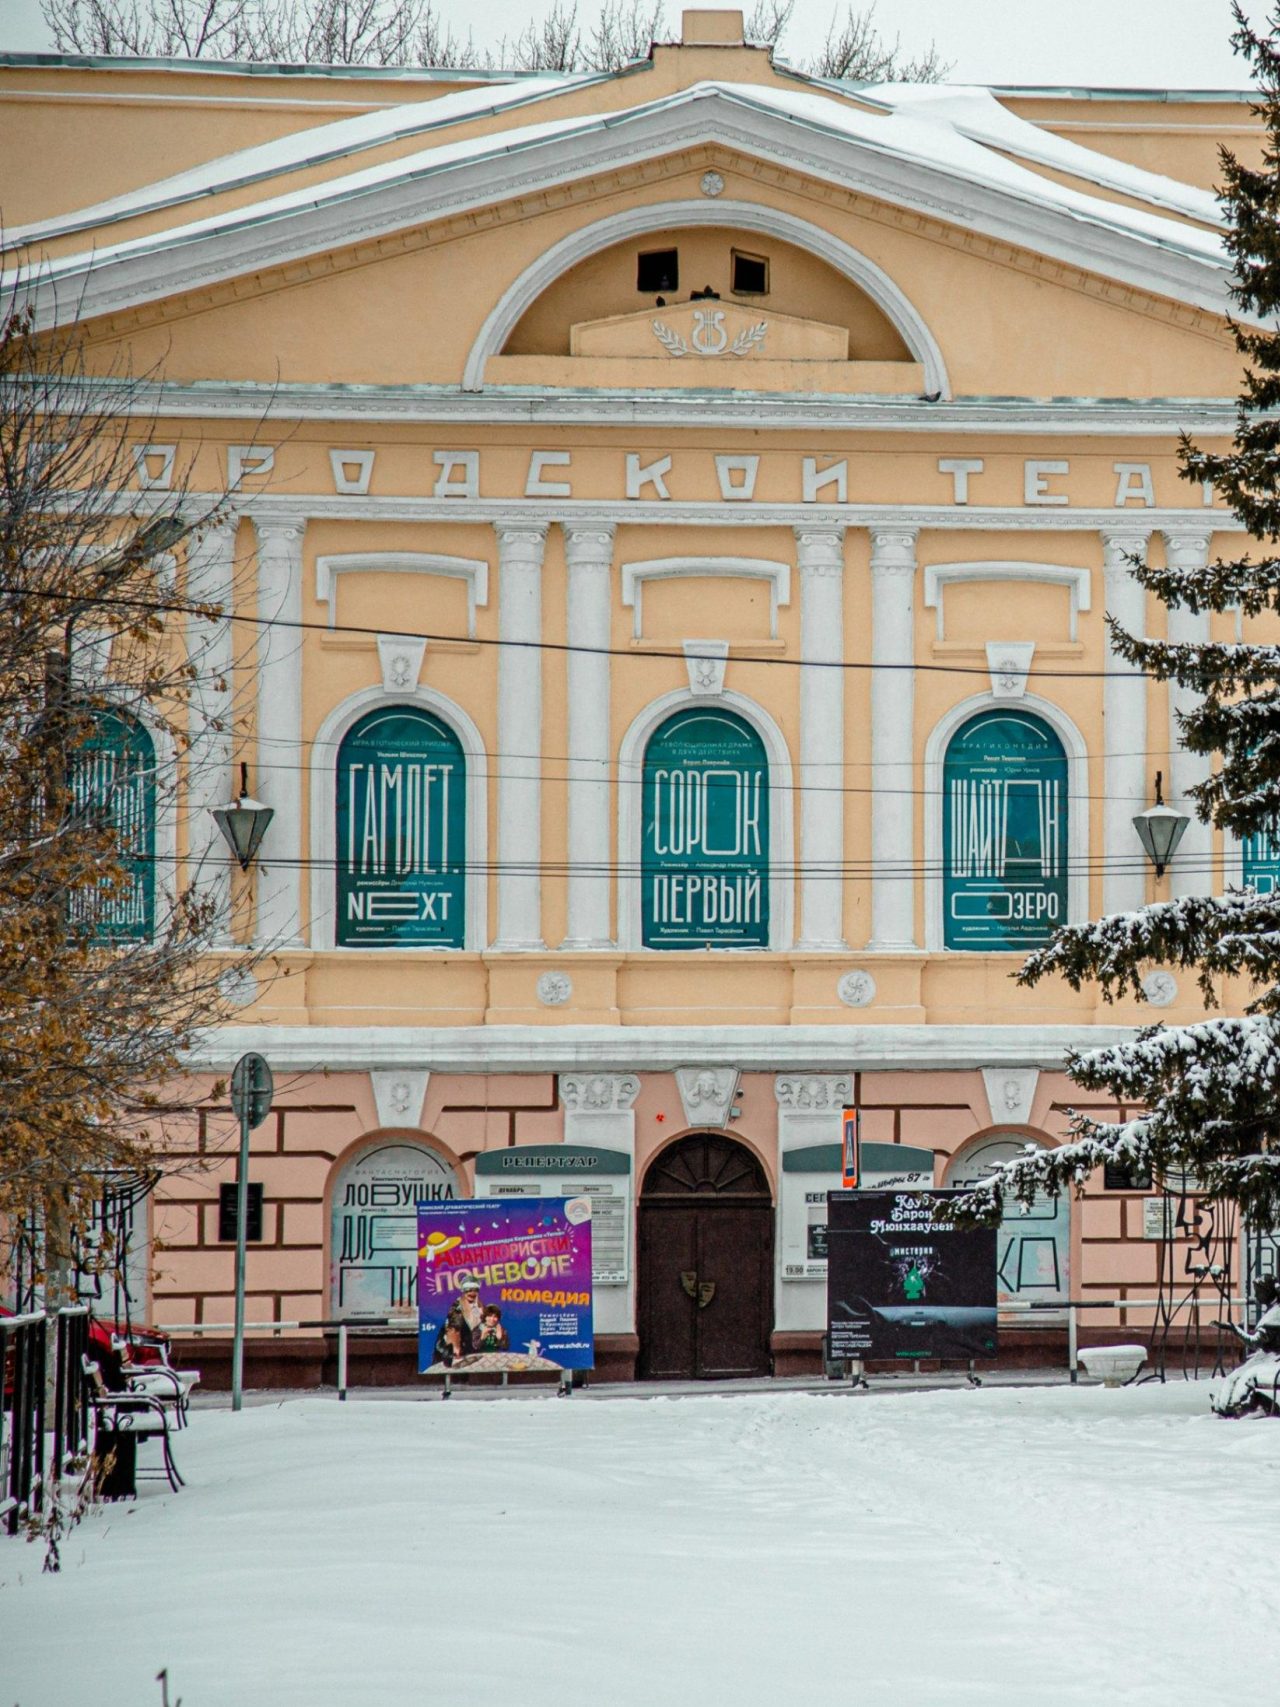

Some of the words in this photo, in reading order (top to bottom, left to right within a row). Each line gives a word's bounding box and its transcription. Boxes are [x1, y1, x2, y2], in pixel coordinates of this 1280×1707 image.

[28, 441, 848, 503] ГОРОДСКОЙ
[654, 769, 762, 856] СОРОК
[951, 779, 1059, 879] ШАЙТАН
[347, 892, 453, 920] NEXT
[653, 869, 761, 923] ПЕРВЫЙ
[951, 892, 1059, 919] ОЗЕРО
[502, 1156, 598, 1168] РЕПЕРТУАР
[906, 1173, 921, 1182] 87
[343, 1183, 454, 1206] ЛОВУШКА
[500, 1287, 590, 1308] комедия
[421, 1323, 436, 1331] 16+
